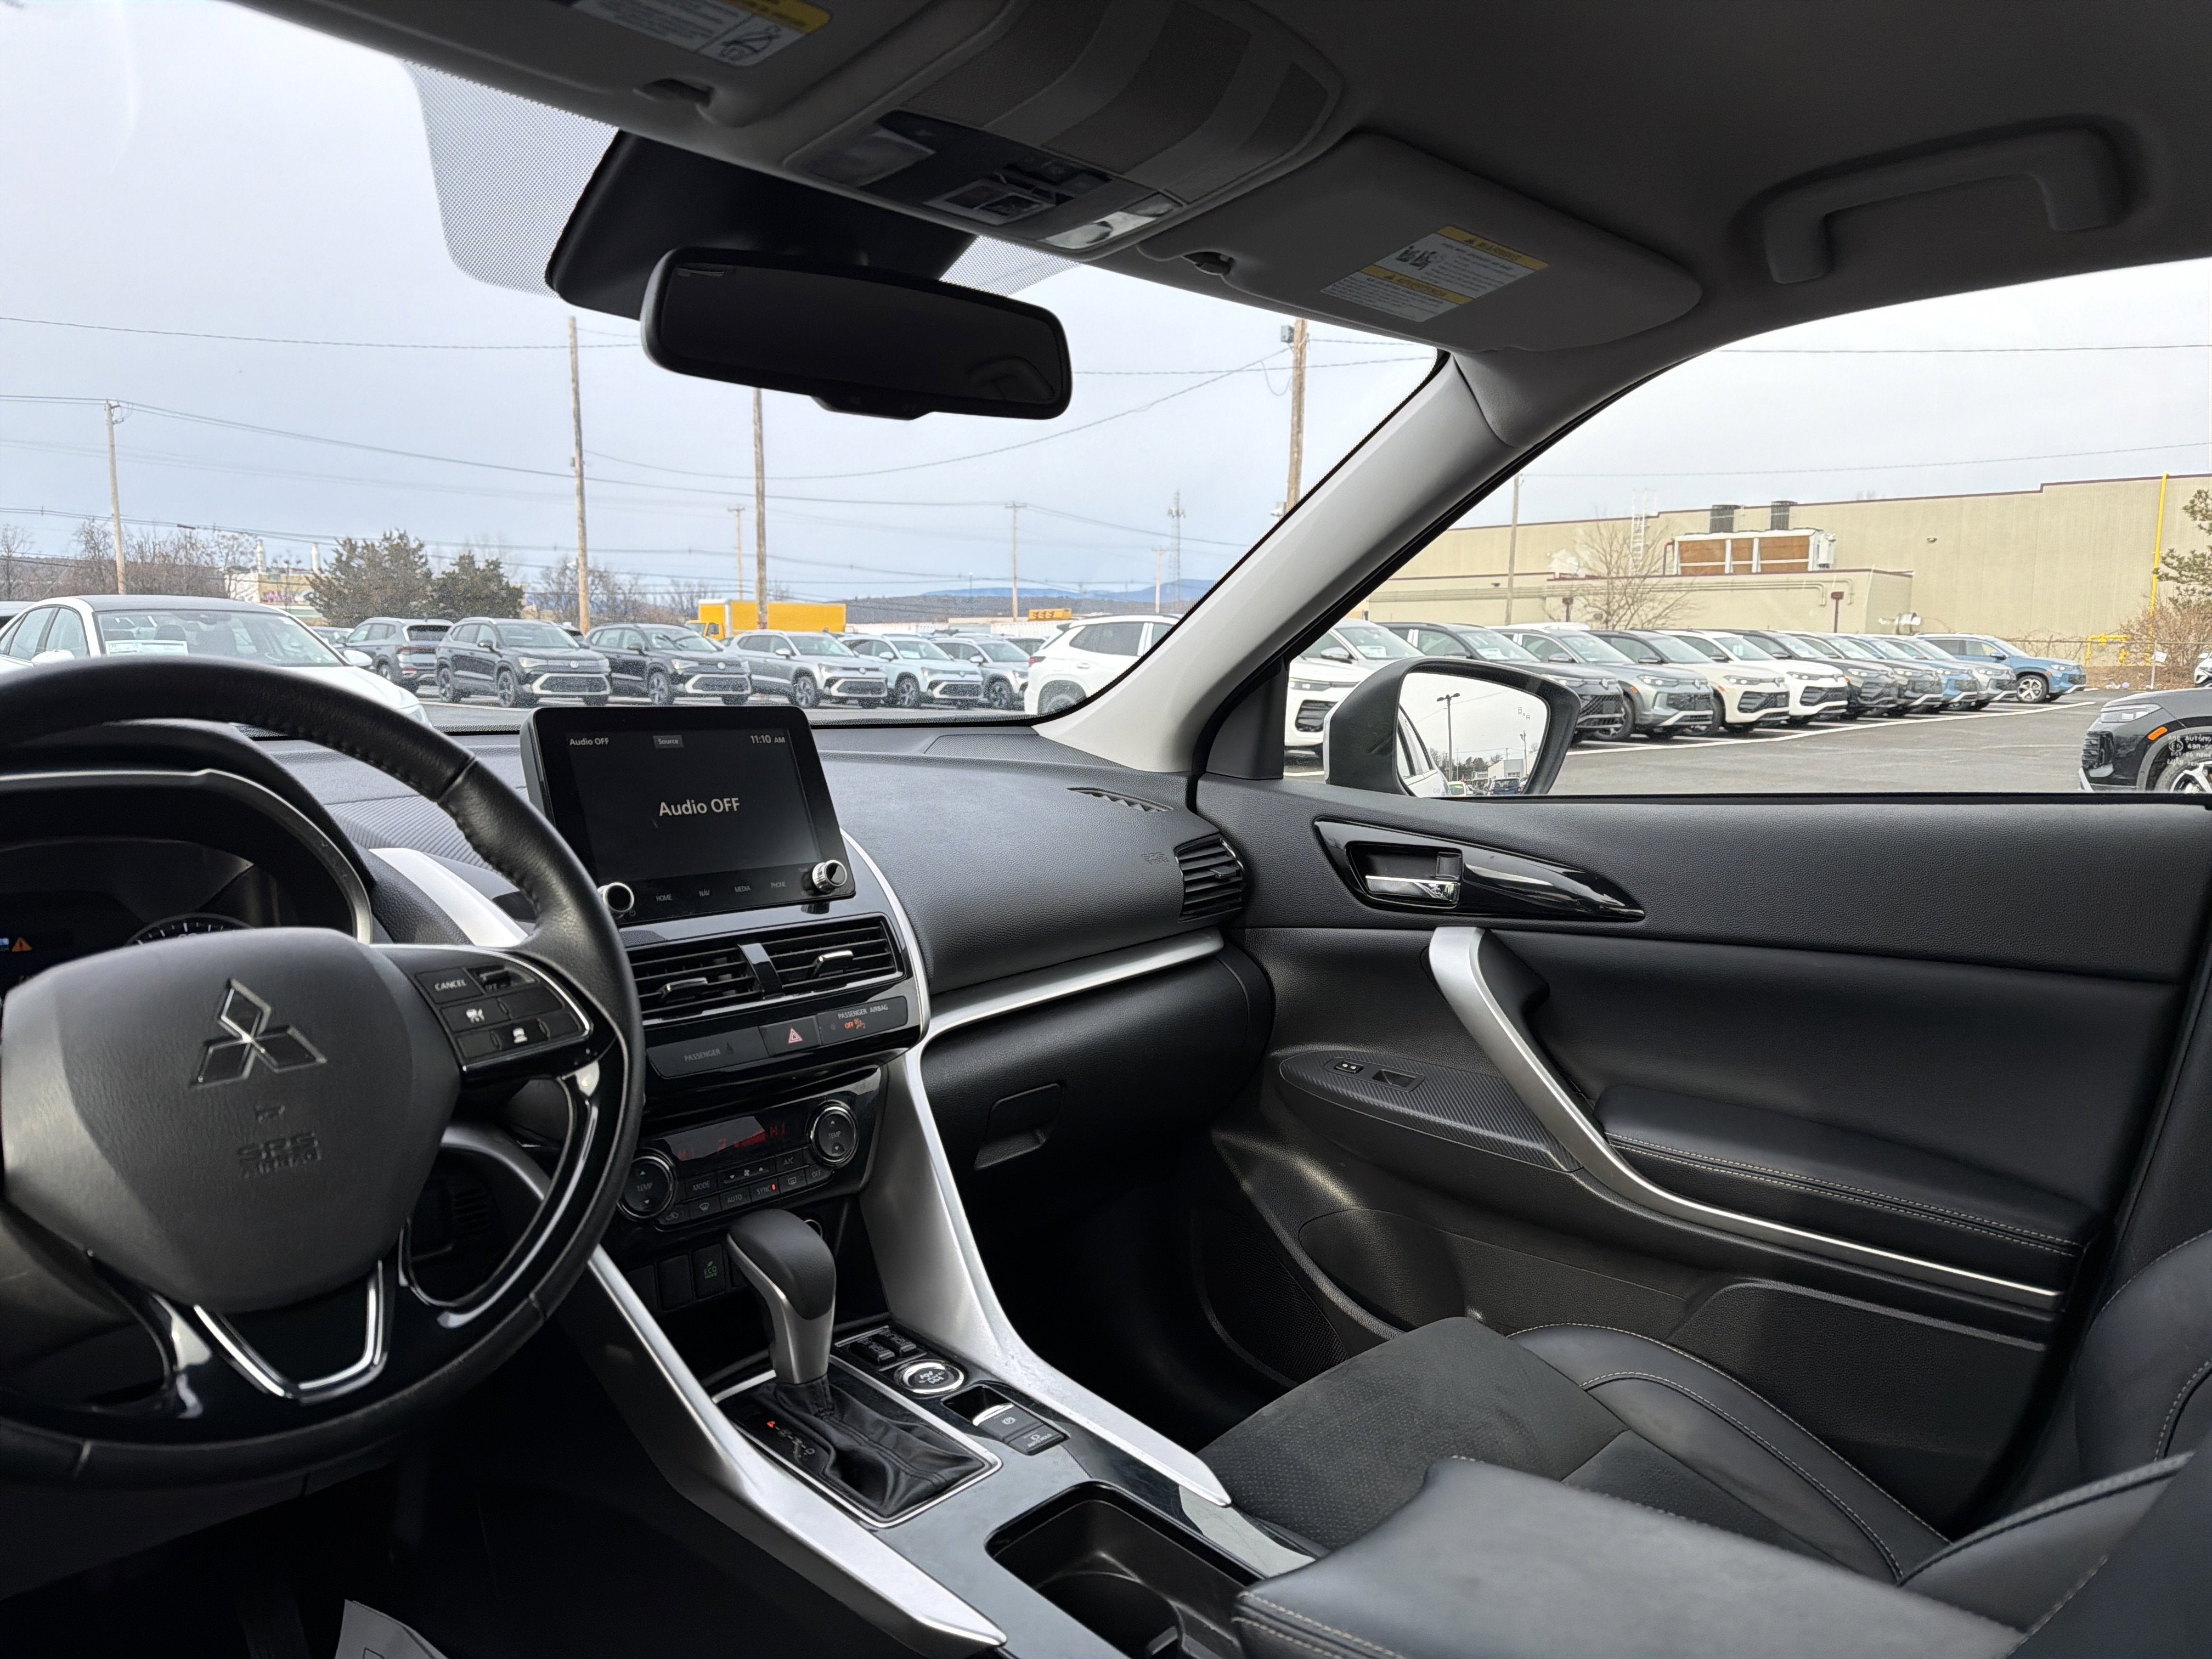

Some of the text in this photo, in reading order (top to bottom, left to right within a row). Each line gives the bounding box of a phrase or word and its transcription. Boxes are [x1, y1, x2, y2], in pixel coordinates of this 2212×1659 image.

[569, 737, 593, 746] Audio
[750, 735, 771, 744] 11:10
[659, 797, 740, 816] Audio OFF
[435, 979, 467, 991] CANCEL
[838, 1004, 889, 1020] PASSENGER AIRBAG
[844, 1022, 854, 1030] OFF
[684, 1048, 721, 1062] PASSENGER
[828, 1131, 841, 1139] TEMP
[811, 1169, 822, 1178] OFF
[636, 1182, 653, 1192] TEMP
[692, 1181, 710, 1191] MODE
[756, 1186, 772, 1195] SYNC
[727, 1193, 743, 1204] AUTO
[704, 1266, 717, 1276] ECO
